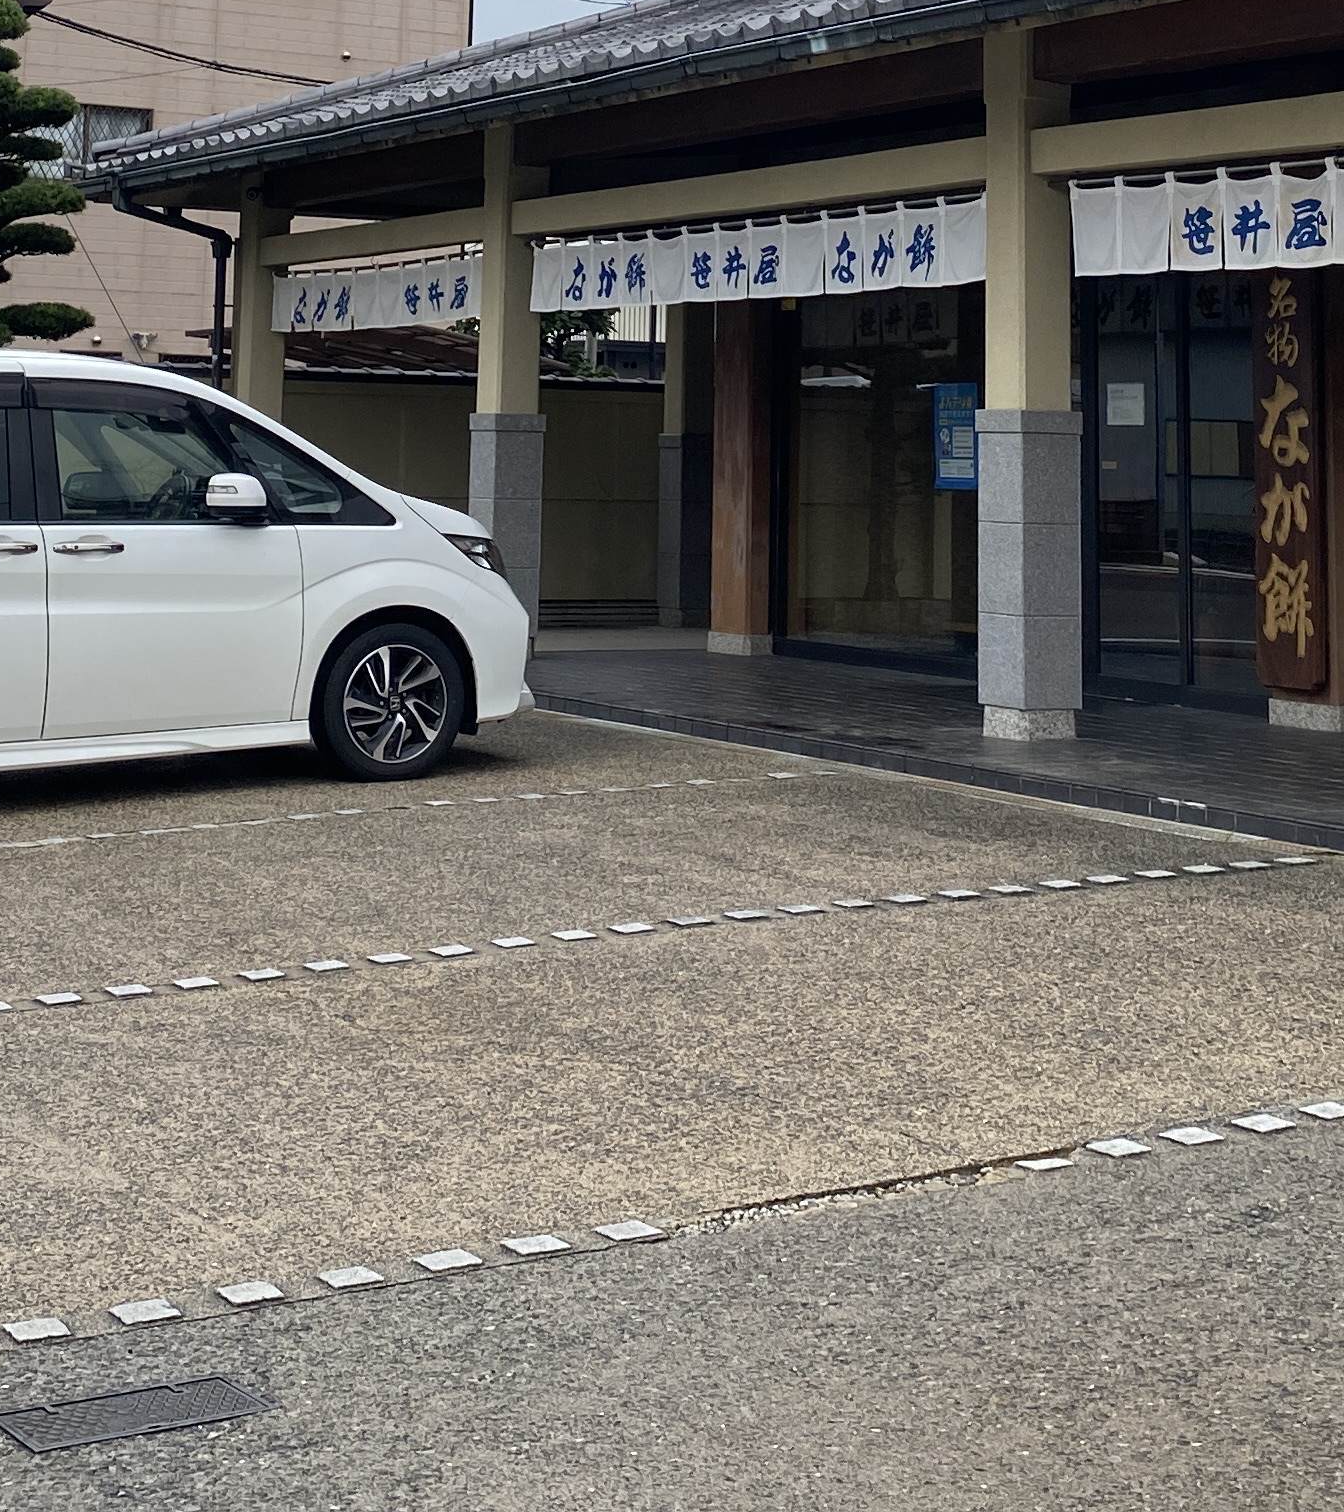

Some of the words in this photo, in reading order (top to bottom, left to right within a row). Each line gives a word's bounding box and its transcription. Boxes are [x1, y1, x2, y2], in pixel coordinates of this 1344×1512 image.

[1181, 199, 1327, 256] 笹井屋
[564, 252, 647, 302] なが餅
[691, 243, 780, 290] 笹井屋
[831, 222, 937, 285] なが餅
[294, 286, 351, 325] なが餅
[405, 276, 469, 315] 笹井屋
[1260, 374, 1316, 658] なが餅
